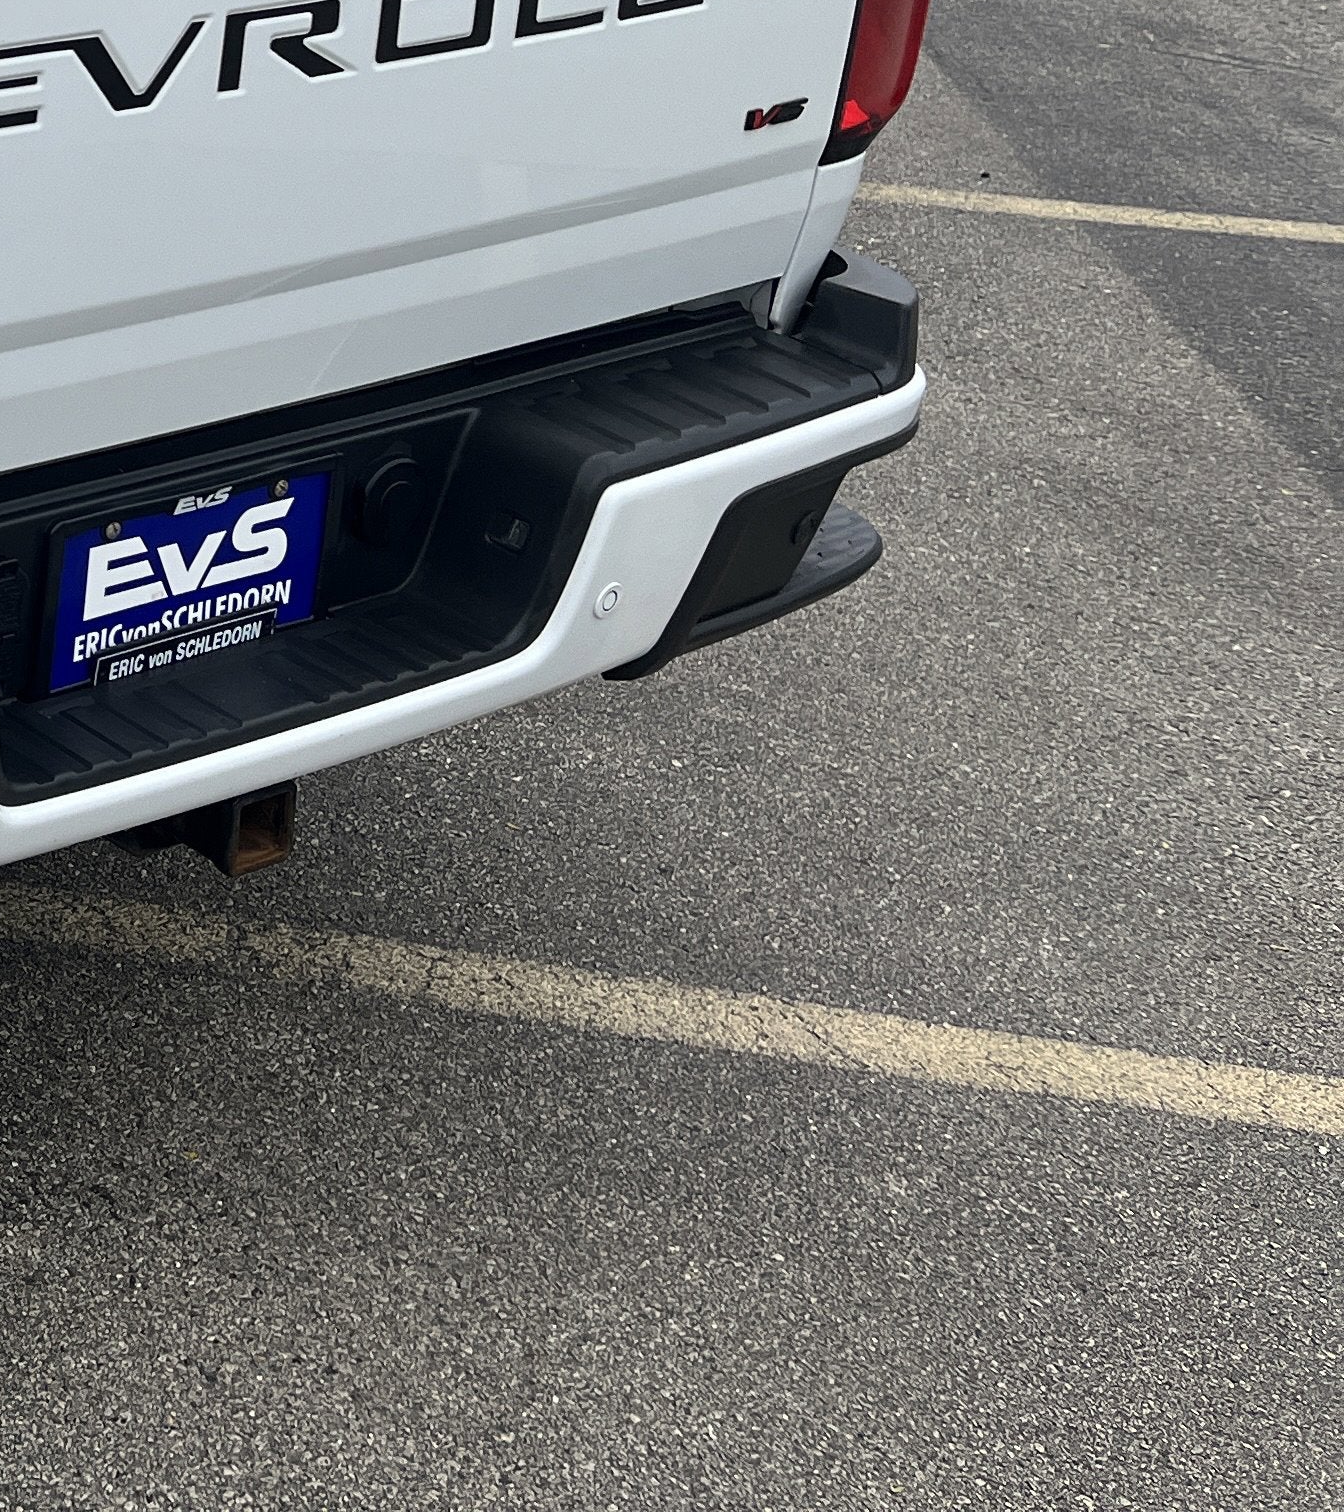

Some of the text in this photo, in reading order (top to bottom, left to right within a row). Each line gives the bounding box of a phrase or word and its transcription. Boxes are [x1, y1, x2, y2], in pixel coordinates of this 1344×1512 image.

[743, 96, 809, 131] V6
[108, 620, 263, 681] ERIC von SCHLEDORN
